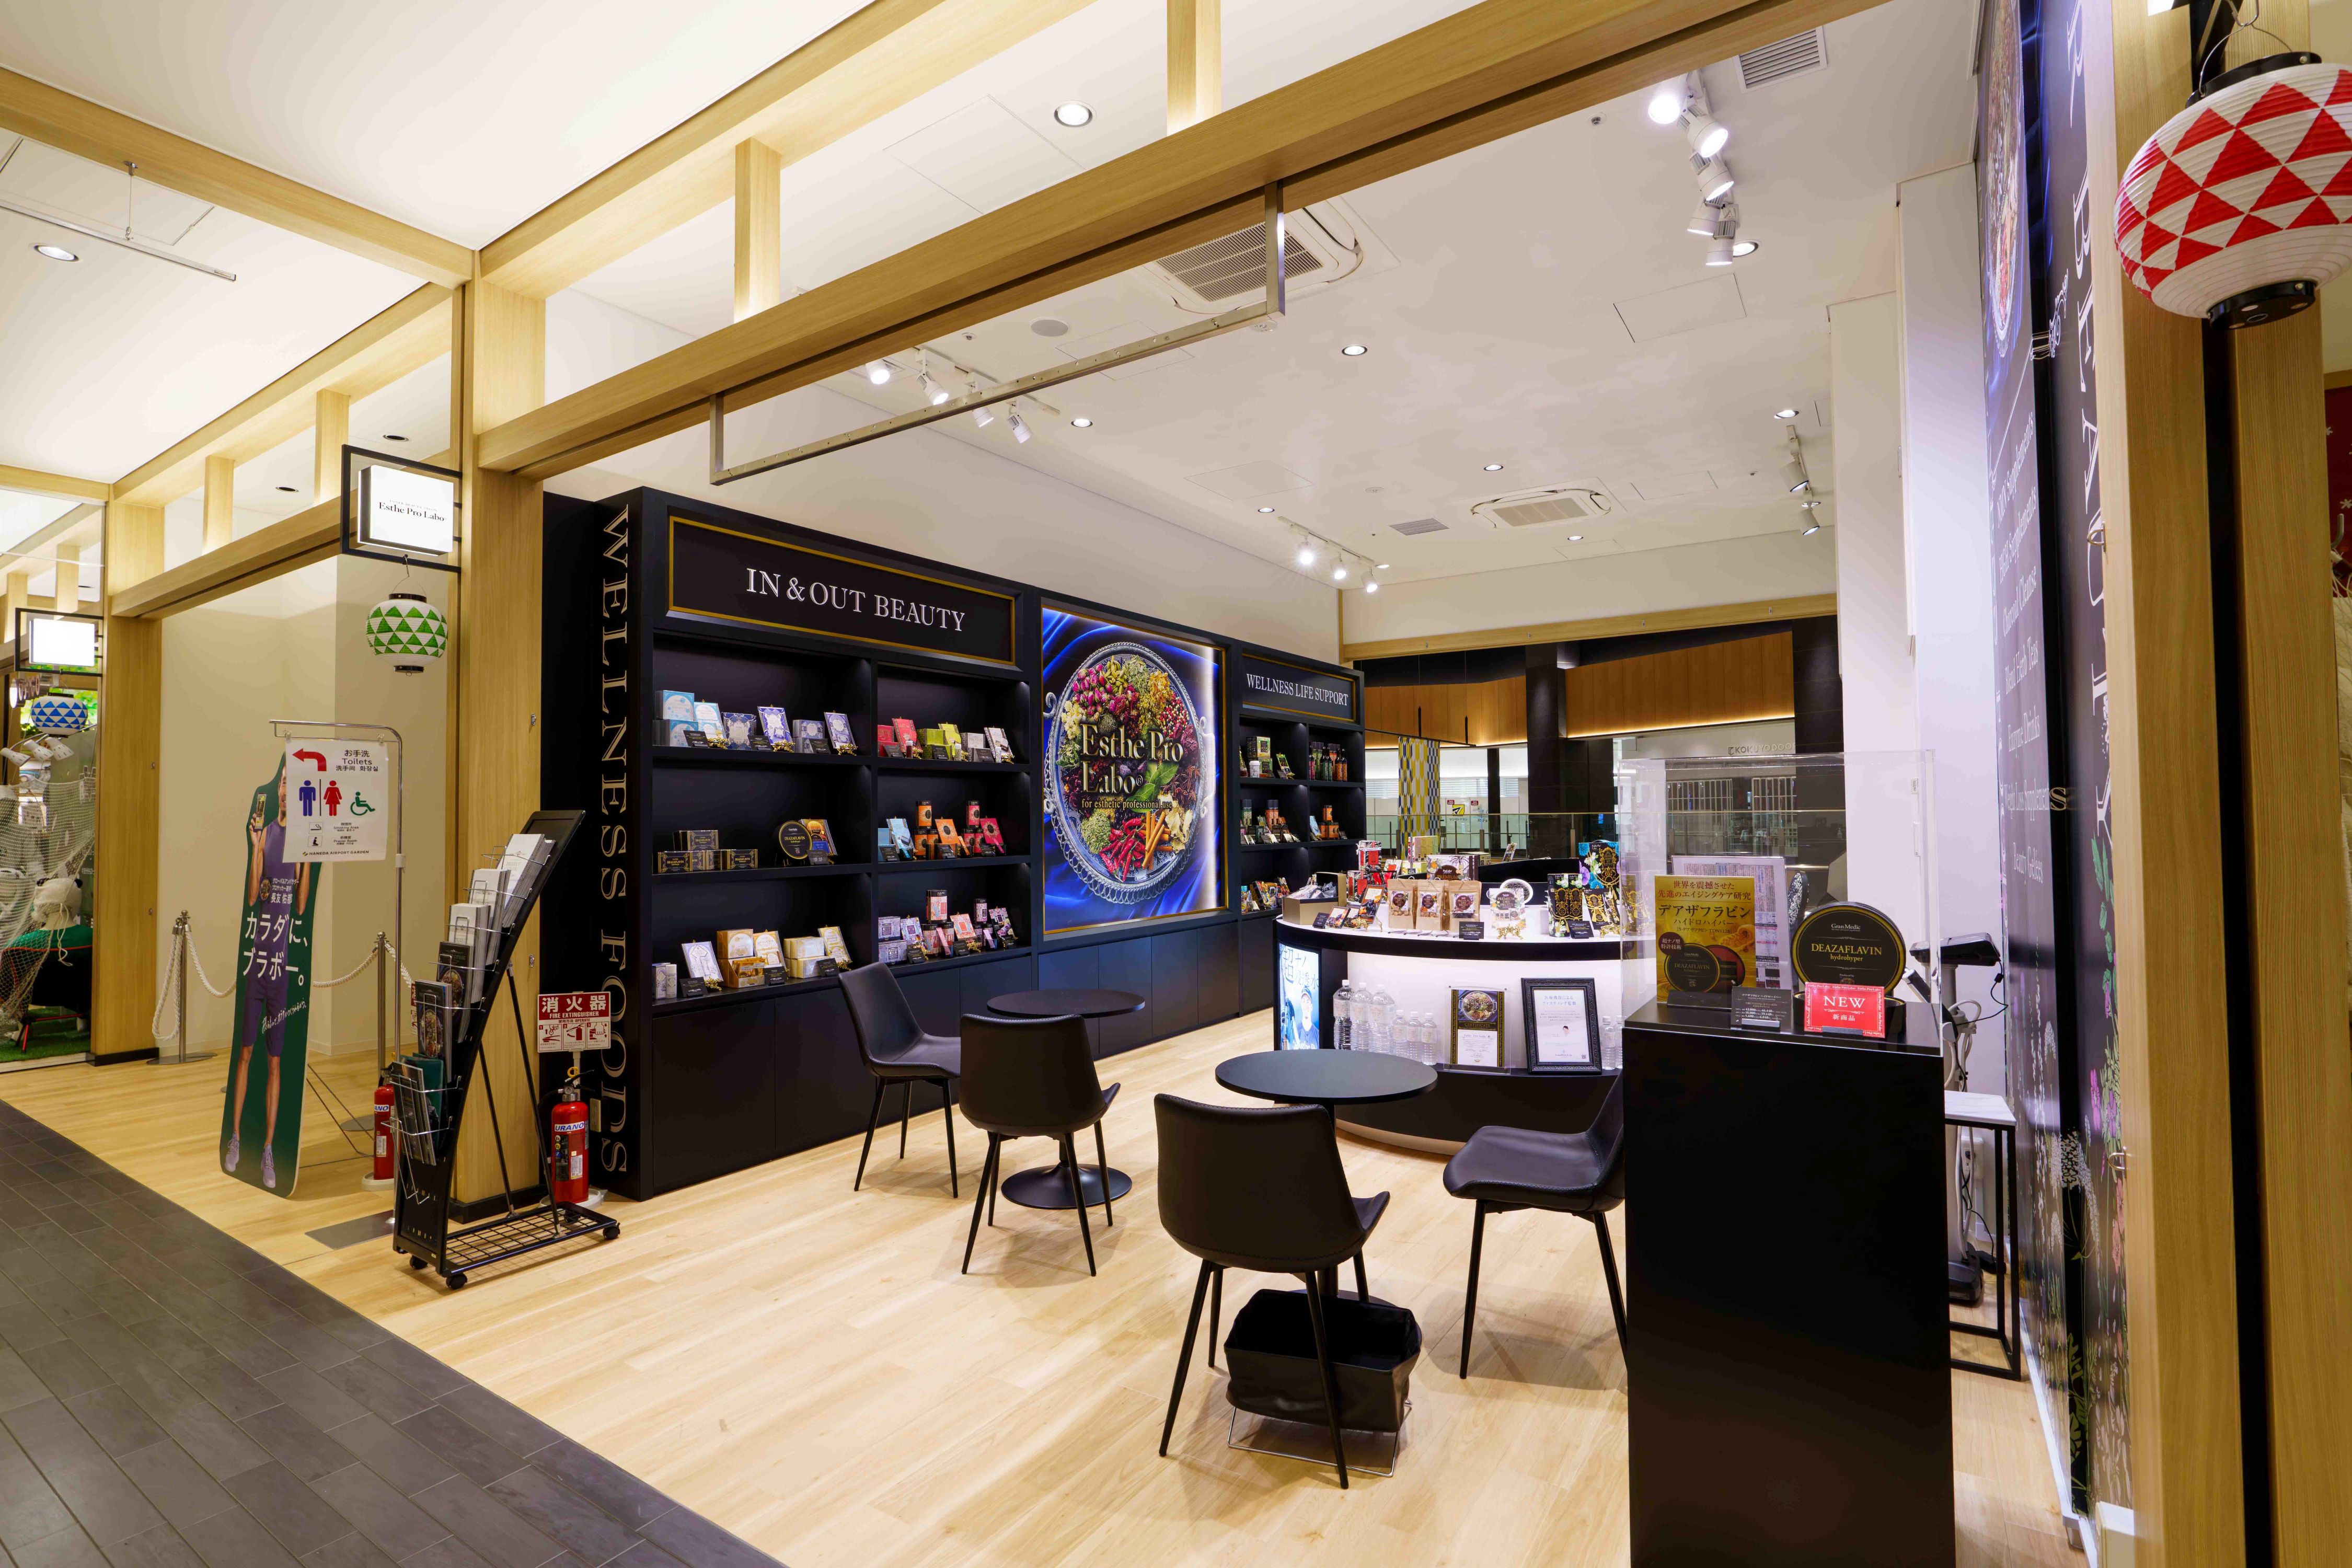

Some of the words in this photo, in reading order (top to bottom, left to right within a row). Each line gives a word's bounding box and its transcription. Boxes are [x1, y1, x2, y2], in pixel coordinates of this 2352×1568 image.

[2007, 411, 2034, 501] Supplements
[378, 502, 405, 513] Esthe
[407, 508, 422, 517] Pro
[424, 511, 444, 522] Labo
[2009, 486, 2037, 563] Supplements
[746, 568, 780, 597] IN
[787, 577, 805, 602] &
[810, 582, 866, 613] OUT
[874, 594, 965, 631] BEAUTY
[2019, 566, 2037, 611] Cleanse
[2005, 659, 2016, 695] Blend
[2016, 644, 2027, 684] Herb
[2027, 636, 2038, 671] Teas
[601, 503, 628, 900] WELLNESS
[1247, 674, 1294, 695] WELLNESS
[1295, 684, 1313, 699] LIFE
[1315, 688, 1348, 706] SUPPORT
[2024, 705, 2040, 744] Drinks
[1080, 723, 1145, 759] Esthe
[1149, 731, 1184, 762] Pro
[1081, 799, 1092, 808] for
[1094, 799, 1120, 809] esthetic
[1123, 799, 1161, 810] professional
[2013, 842, 2026, 885] Beauty
[1658, 890, 1751, 901] 先進のエイジングケア研究
[1674, 880, 1735, 890] 世界を震撼させた
[1658, 904, 1750, 918] デアザフラビン
[1674, 918, 1734, 927] ハイドロハイパー
[245, 912, 308, 947] カラダに、
[1811, 943, 1882, 955] DEAZAFLAVIN
[1830, 954, 1863, 962] hydrohyper
[243, 947, 304, 986] ブラボー。
[541, 995, 606, 1013] 消火器
[1824, 996, 1865, 1008] NEW
[601, 929, 627, 1172] FOODS
[555, 1122, 584, 1131] URANO
